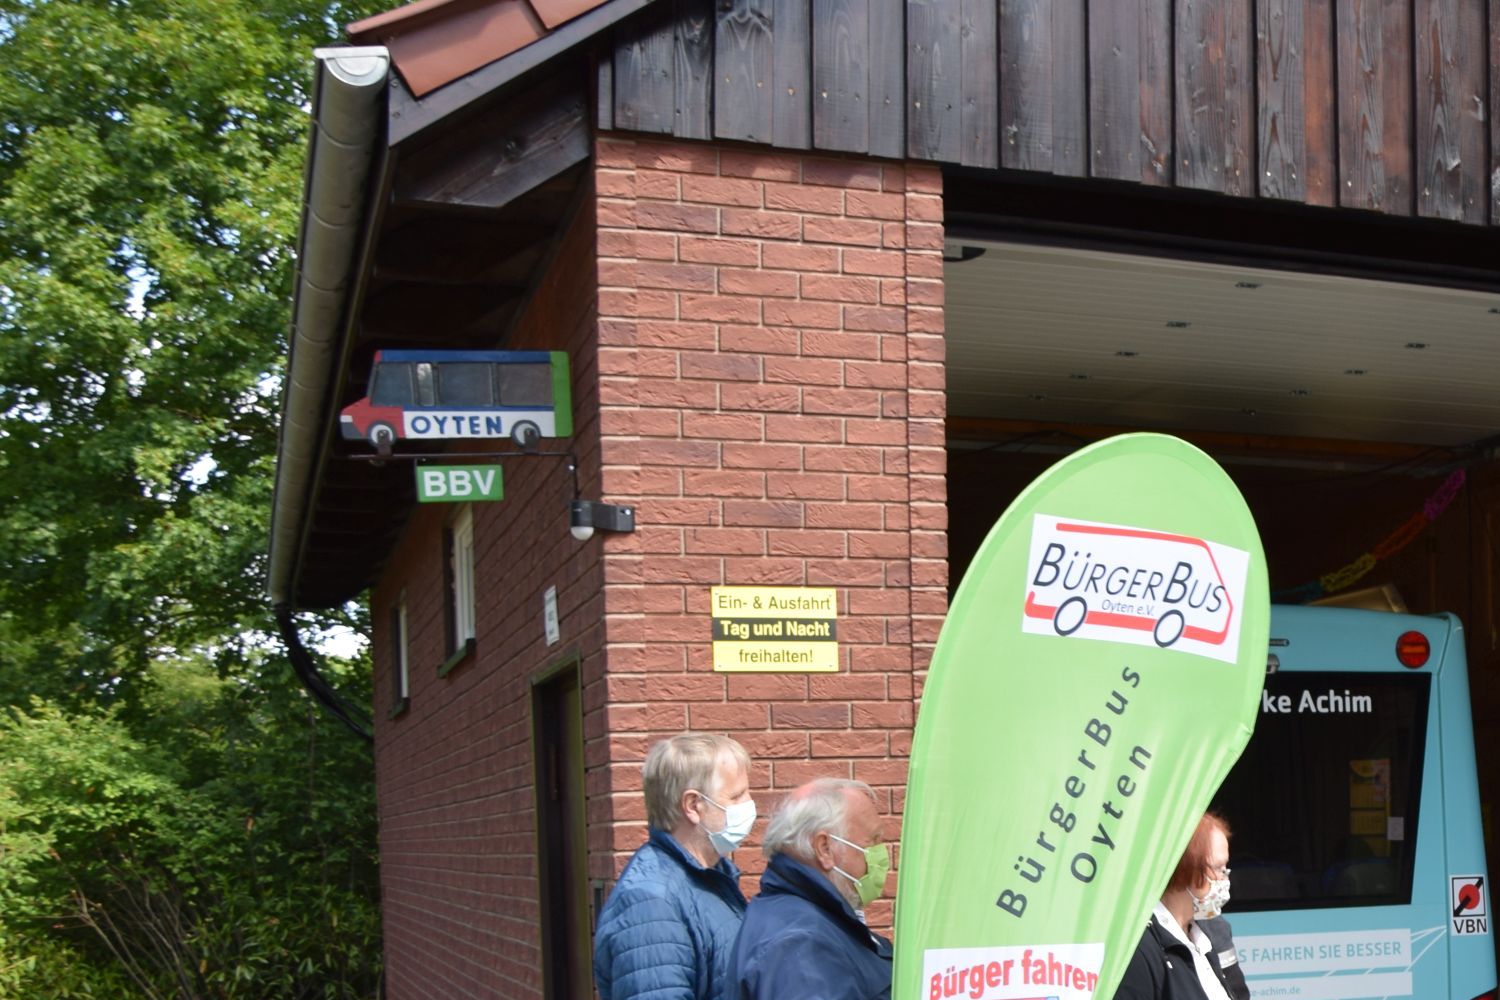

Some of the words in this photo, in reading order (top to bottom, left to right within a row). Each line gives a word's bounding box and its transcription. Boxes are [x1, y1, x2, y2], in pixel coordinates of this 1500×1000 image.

[410, 415, 503, 435] OYTEN
[423, 469, 496, 497] BBV
[718, 595, 747, 609] Ein-
[753, 596, 763, 609] &
[768, 595, 831, 611] Ausfahrt
[1101, 599, 1134, 615] Oyten
[719, 620, 750, 639] Tag
[753, 620, 783, 636] und
[786, 620, 831, 637] Nacht
[738, 648, 814, 664] freihalten!
[1262, 689, 1292, 713] ke
[1298, 689, 1372, 713] Achim
[995, 666, 1141, 919] BürgerBus
[1070, 745, 1152, 884] Oyten
[1453, 918, 1487, 934] VBN
[1252, 945, 1314, 963] FAHREN
[1319, 944, 1341, 959] SIE
[1346, 941, 1402, 958] BESSER
[1021, 949, 1100, 993] fahren
[1250, 985, 1302, 998] e-achim.de
